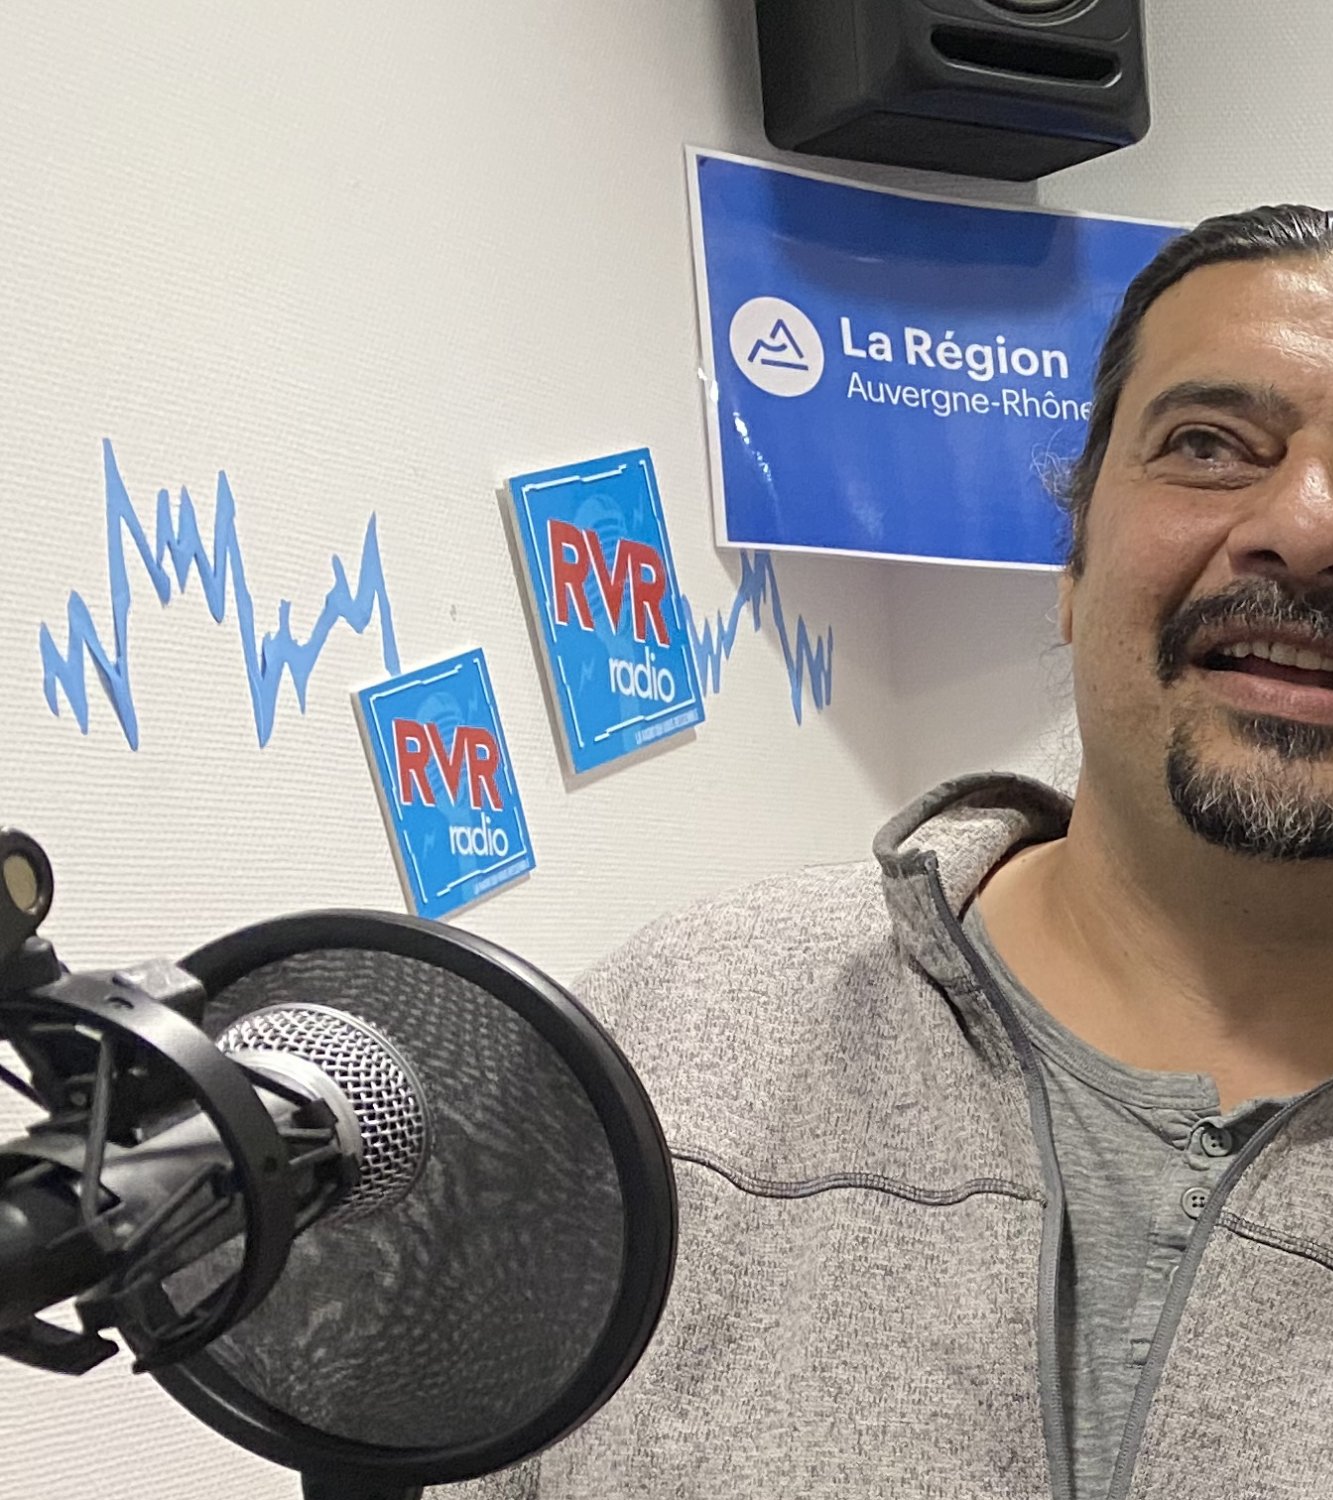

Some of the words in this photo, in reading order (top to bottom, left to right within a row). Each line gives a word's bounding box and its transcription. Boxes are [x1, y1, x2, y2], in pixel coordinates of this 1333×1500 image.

[840, 316, 893, 363] La
[904, 326, 1070, 382] Région
[547, 518, 671, 648] RVR
[608, 646, 676, 704] radio
[392, 718, 504, 812] RVR
[448, 811, 509, 858] radio
